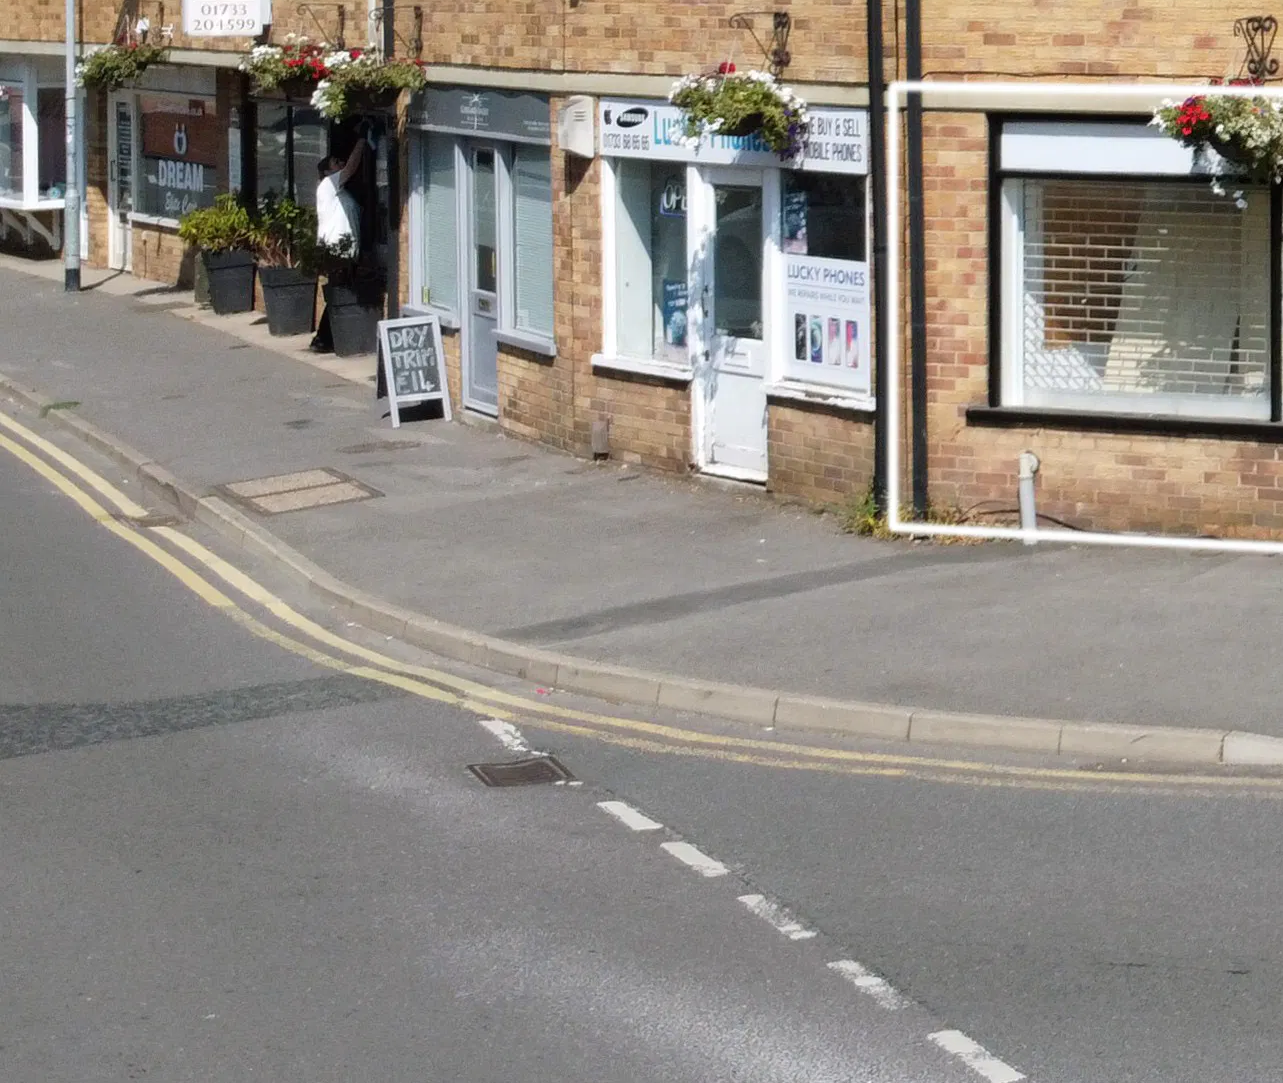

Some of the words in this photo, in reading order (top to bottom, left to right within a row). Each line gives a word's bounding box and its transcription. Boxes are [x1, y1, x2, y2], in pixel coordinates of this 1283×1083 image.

[200, 3, 247, 16] 01733
[193, 18, 255, 31] 204599
[817, 117, 832, 136] BUY
[835, 118, 841, 136] &
[843, 118, 861, 137] SELL
[832, 143, 862, 162] PHONES
[158, 159, 203, 192] DREAM
[787, 264, 820, 281] LUCKY
[823, 268, 865, 286] PHONES
[389, 325, 428, 348] DRY
[392, 347, 436, 369] TRIM
